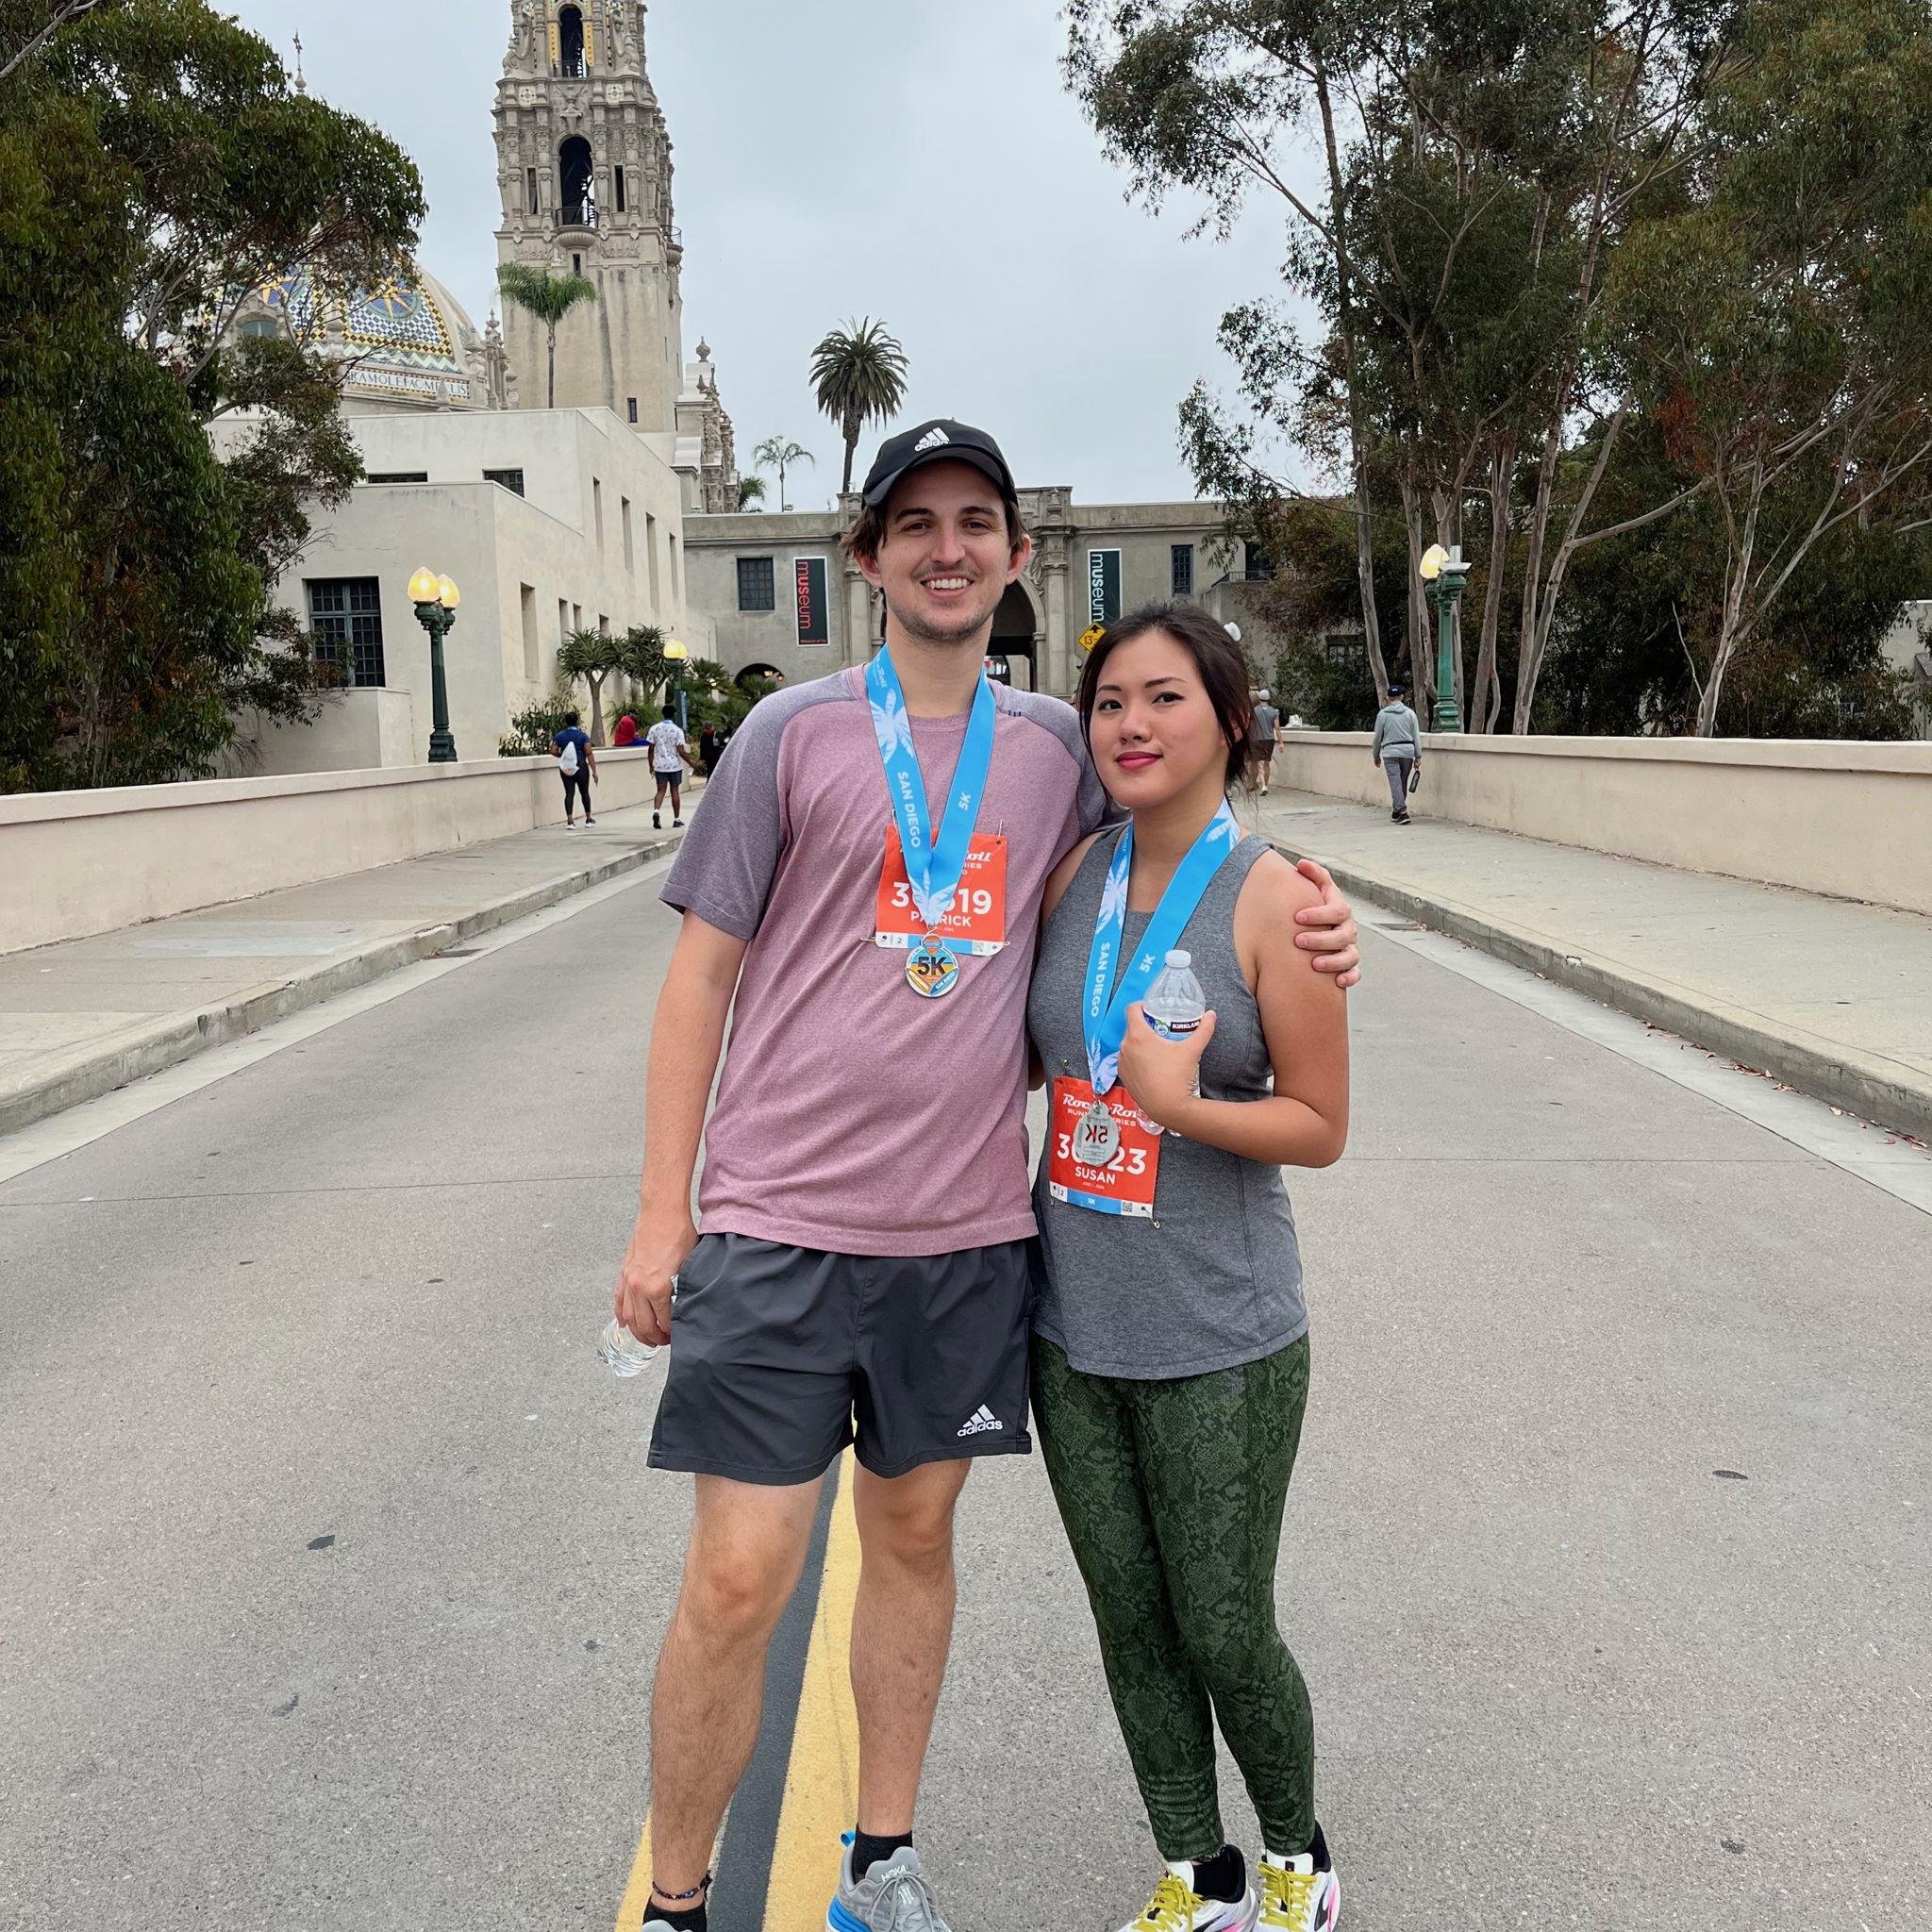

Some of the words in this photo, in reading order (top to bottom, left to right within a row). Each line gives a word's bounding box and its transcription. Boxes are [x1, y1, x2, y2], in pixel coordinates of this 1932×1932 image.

[797, 561, 811, 629] museum
[1091, 554, 1105, 623] museum
[897, 772, 913, 800] SAN
[905, 803, 921, 848] DIEGO
[958, 791, 972, 811] 5K
[891, 881, 992, 915] 319
[910, 911, 972, 927] PRICK
[917, 957, 948, 976] 5K
[1097, 942, 1111, 971] SAN
[1140, 953, 1156, 974] 5K
[1091, 974, 1106, 1017] DIEGO
[1172, 1021, 1200, 1030] KIRKLAN
[1062, 1093, 1091, 1109] Roc
[1057, 1133, 1147, 1175] 323
[1074, 1166, 1116, 1185] SUSAN
[957, 1420, 1004, 1437] adidas
